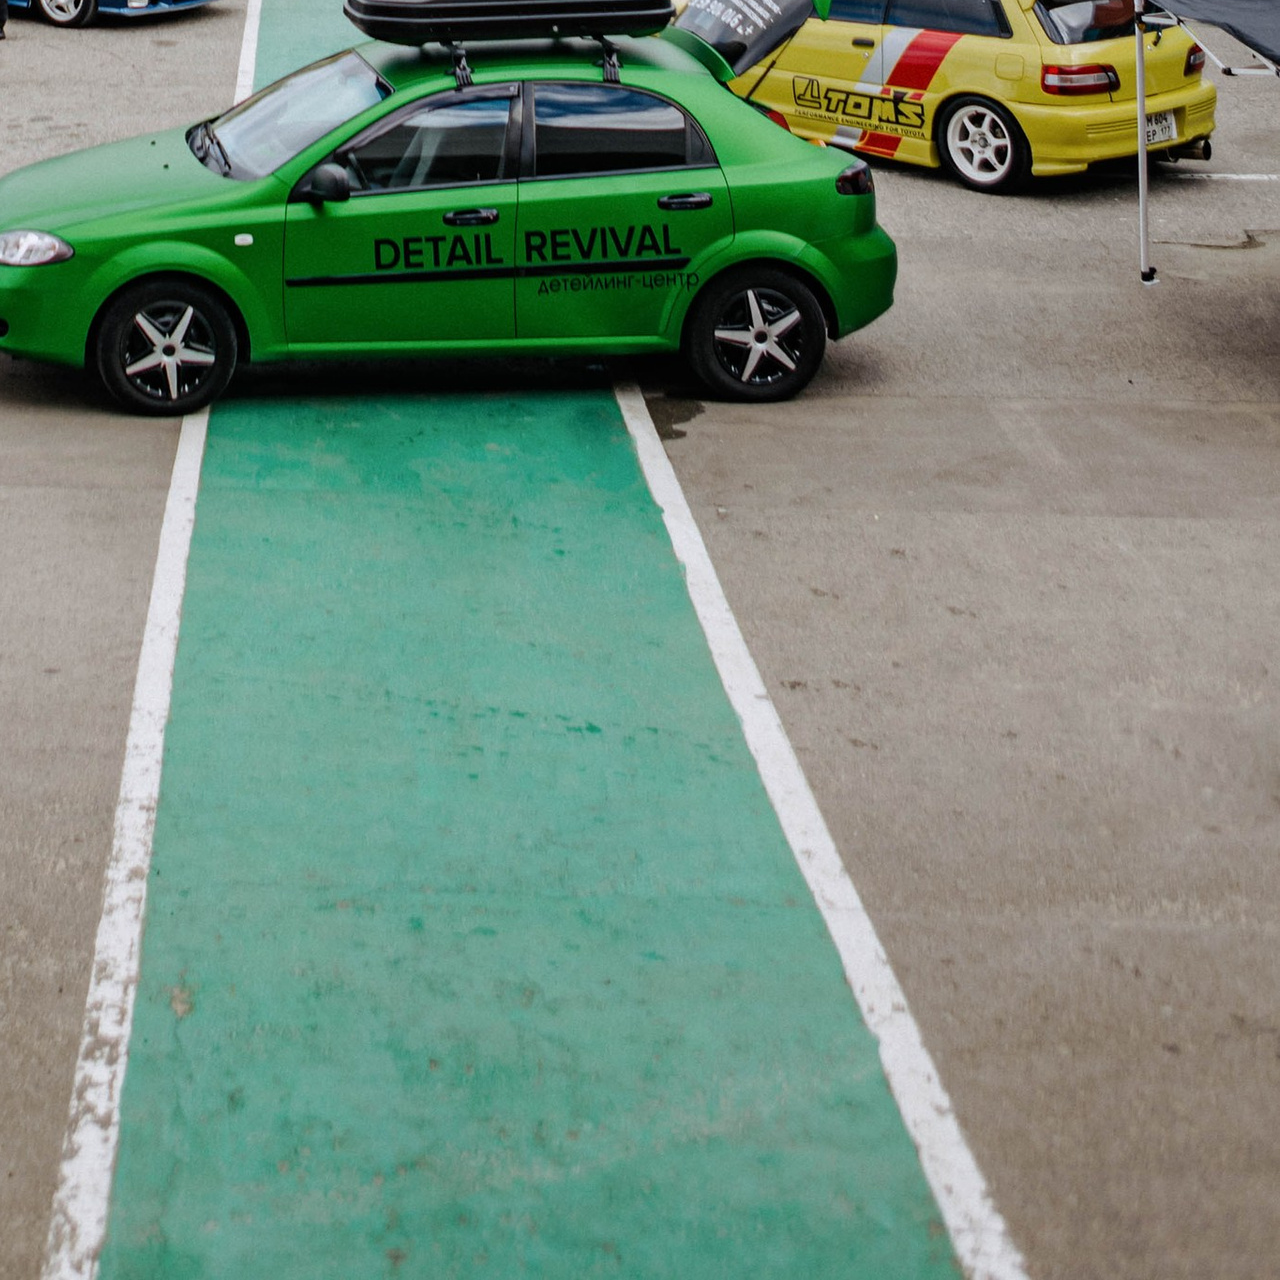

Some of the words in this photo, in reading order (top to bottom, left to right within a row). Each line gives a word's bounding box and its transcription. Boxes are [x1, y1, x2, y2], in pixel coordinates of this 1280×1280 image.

[794, 108, 839, 123] PERFORMANCE
[841, 117, 884, 131] ENGINEERING
[886, 125, 899, 133] FOR
[901, 128, 926, 139] TOYOTA
[1154, 112, 1168, 126] 604
[1161, 125, 1170, 135] 177
[374, 233, 504, 270] DETAIL
[524, 224, 682, 263] REVIVAL
[537, 272, 700, 296] детейлинг-центр
